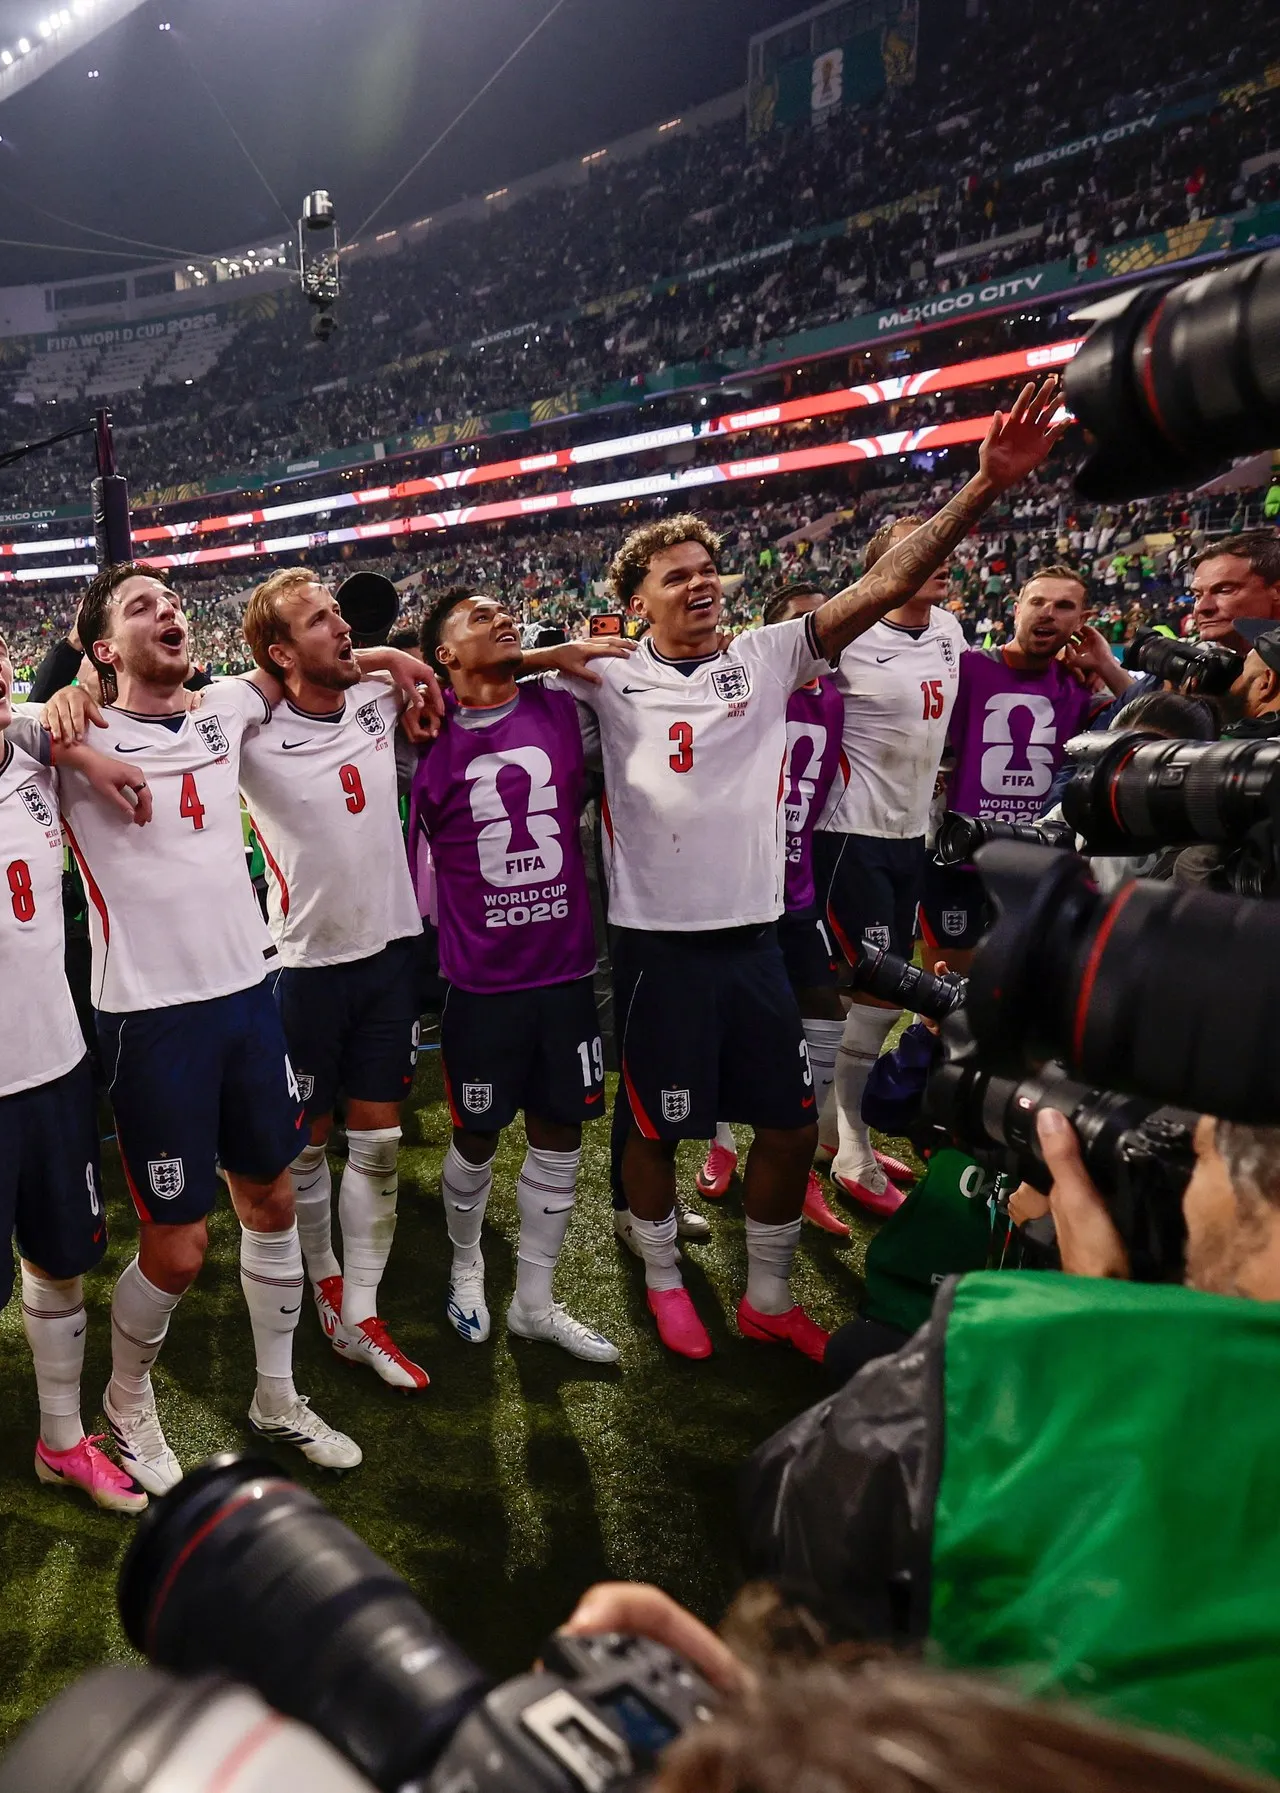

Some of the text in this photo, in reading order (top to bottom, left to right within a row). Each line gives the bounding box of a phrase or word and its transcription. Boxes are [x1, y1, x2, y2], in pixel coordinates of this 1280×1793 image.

[1101, 114, 1158, 144] CITY
[878, 273, 1044, 330] MEXICO CITY
[46, 335, 79, 352] FIFA
[135, 323, 164, 339] CUP
[31, 509, 56, 518] CITY
[920, 680, 944, 720] 15
[668, 721, 694, 774] 3
[180, 772, 206, 830] 4
[338, 763, 366, 814] 9
[1002, 775, 1035, 787] FIFA
[979, 799, 1045, 810] WORLD CU
[505, 855, 546, 874] FIFA
[6, 859, 36, 923] 8
[483, 883, 567, 907] WORLD CUP
[484, 899, 569, 928] 2026
[284, 1053, 302, 1104] 4
[576, 1035, 605, 1088] 19
[798, 1038, 814, 1087] 3
[85, 1161, 100, 1217] 8
